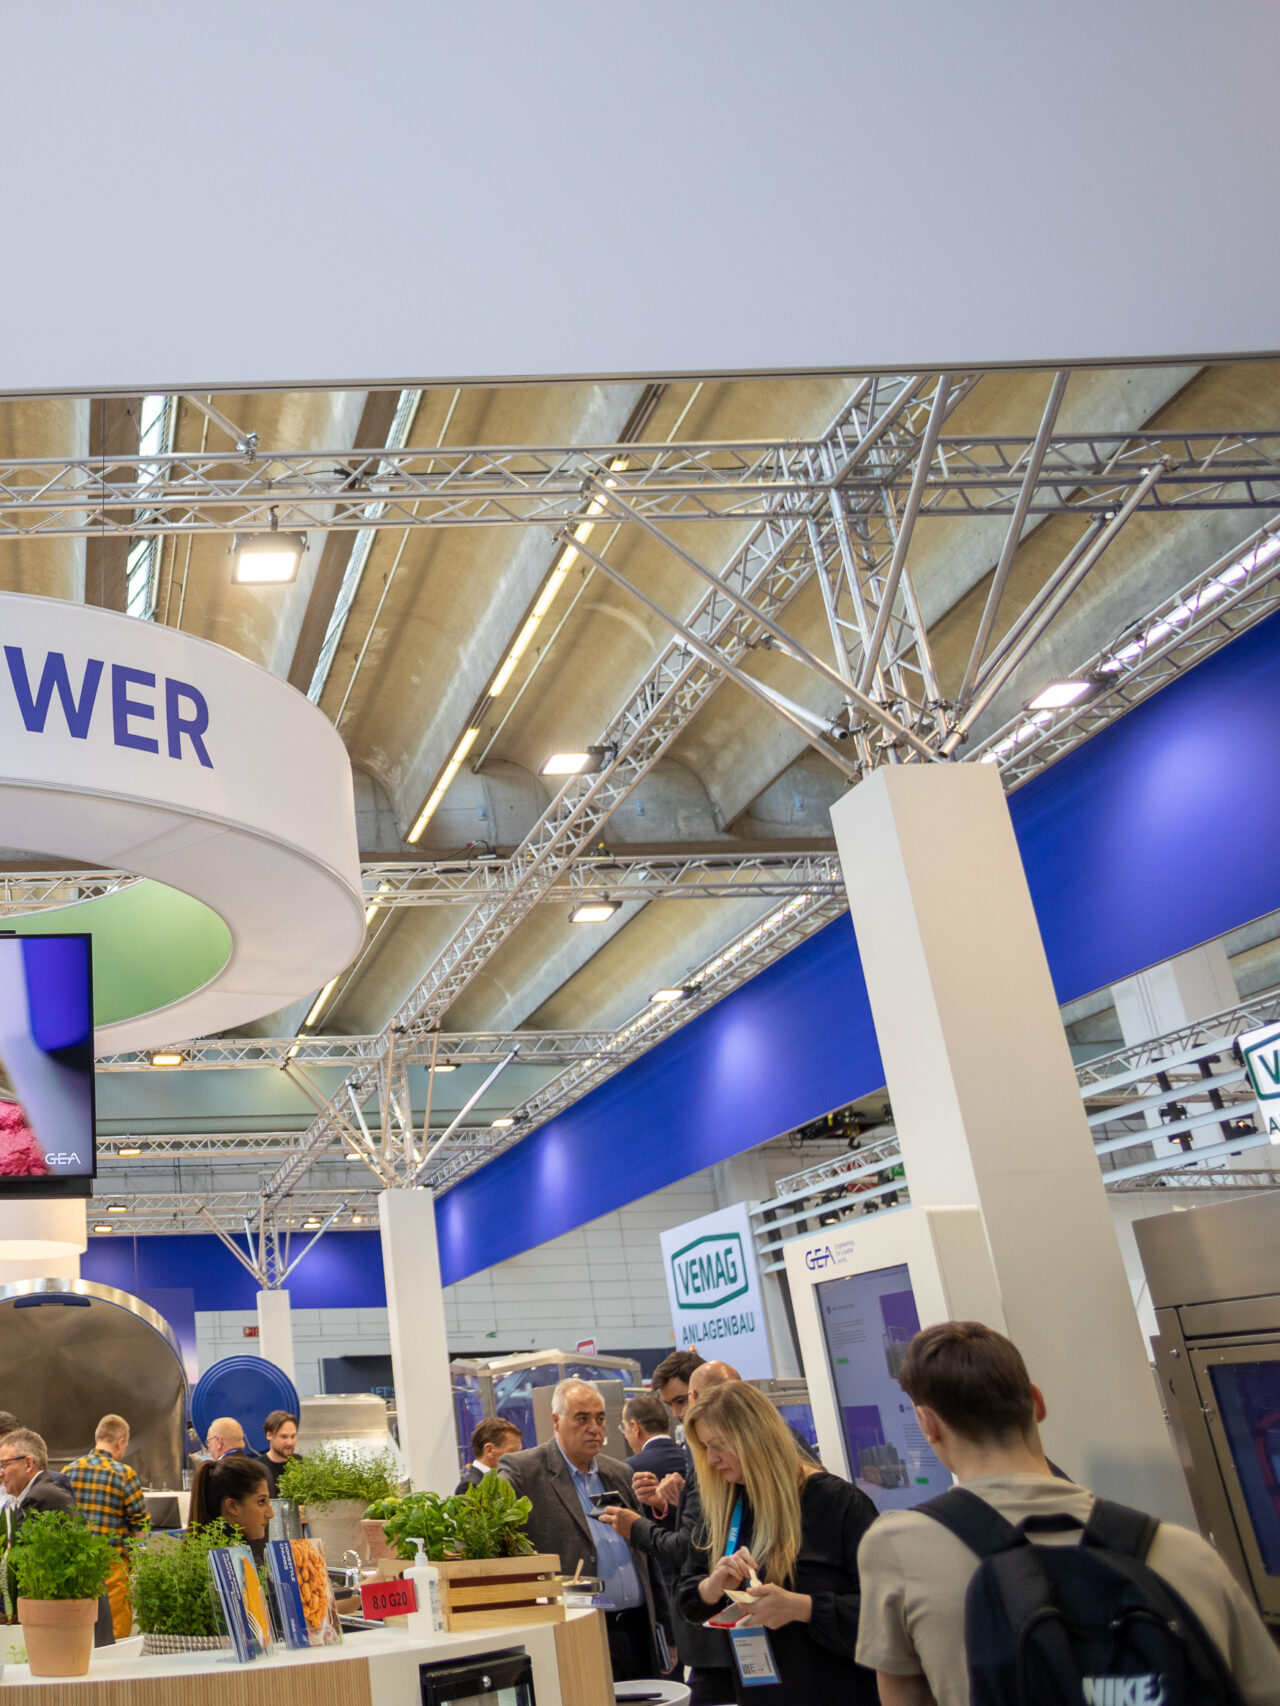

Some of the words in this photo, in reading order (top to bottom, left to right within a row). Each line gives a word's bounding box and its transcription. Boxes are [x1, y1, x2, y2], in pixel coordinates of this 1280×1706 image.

[45, 1152, 81, 1165] GEA
[677, 1247, 738, 1296] VEMAG
[805, 1245, 836, 1271] GEA
[682, 1311, 755, 1345] ANLAGENBAU
[284, 1542, 296, 1582] HOMESTYLE
[372, 1594, 387, 1610] 8.0
[388, 1591, 408, 1608] G20
[1082, 1673, 1154, 1706] NIKE
